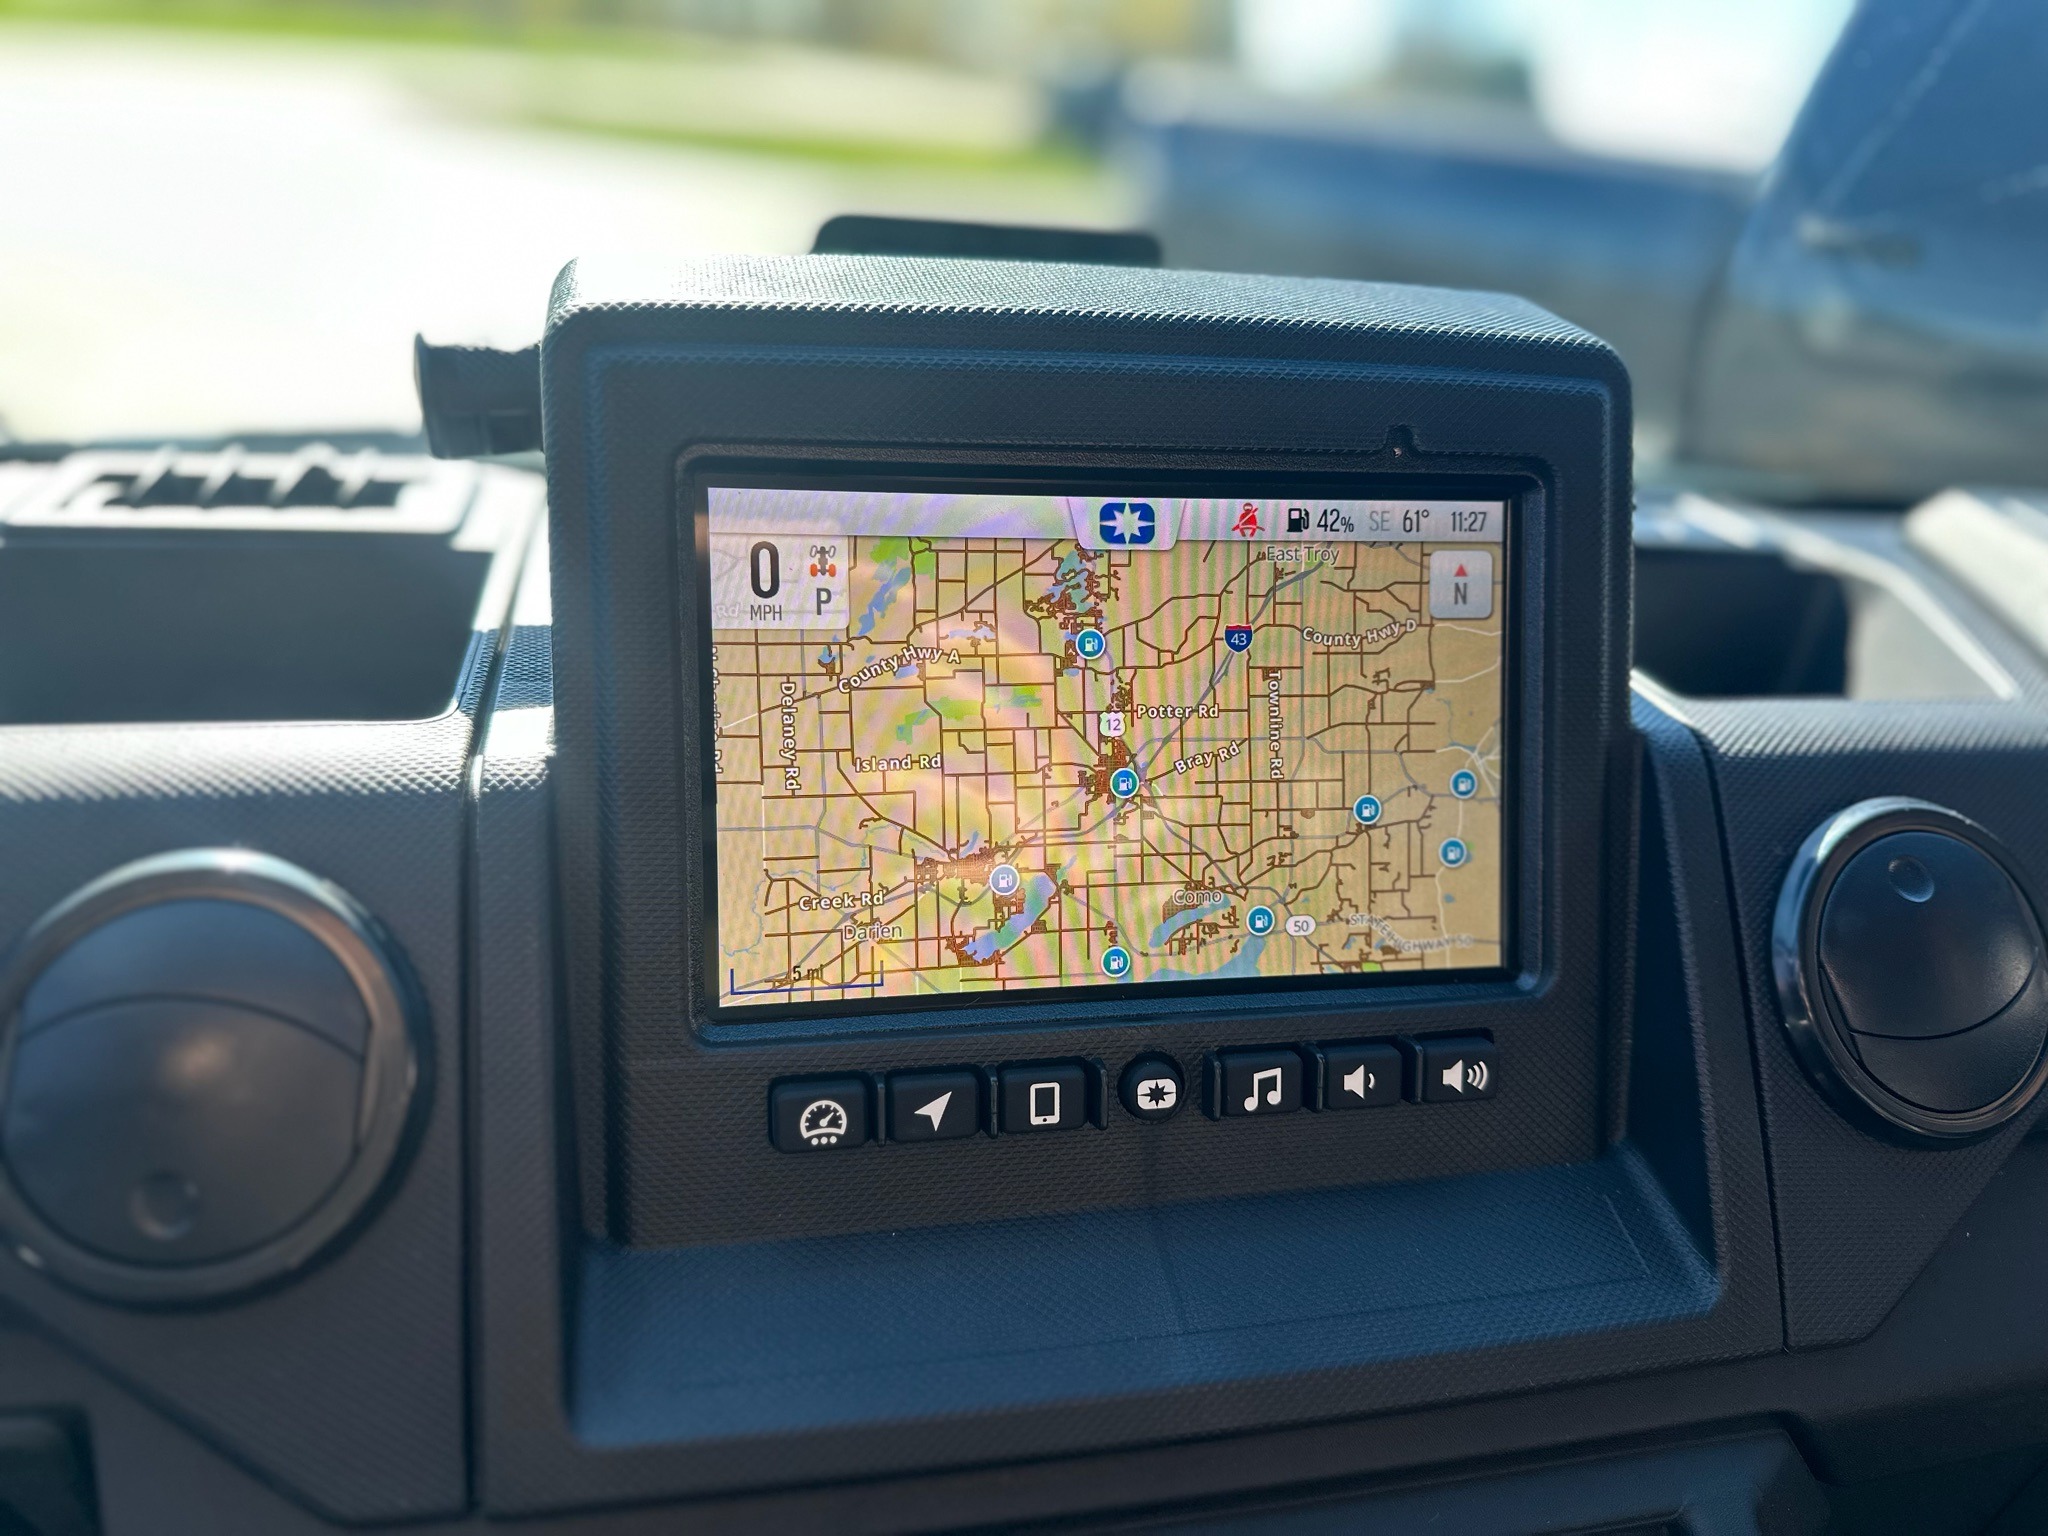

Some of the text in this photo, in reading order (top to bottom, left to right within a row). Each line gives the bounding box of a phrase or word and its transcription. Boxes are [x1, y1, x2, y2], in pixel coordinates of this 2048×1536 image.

[1317, 508, 1354, 533] 42%
[1369, 510, 1391, 532] SE
[1450, 511, 1487, 532] 11:27
[1266, 545, 1339, 565] East Troy
[750, 540, 780, 599] 0
[816, 587, 832, 616] P
[1453, 582, 1468, 605] N
[750, 604, 783, 621] MPH
[1230, 633, 1248, 646] 43
[1302, 618, 1418, 650] County Hwy D
[838, 644, 961, 694] County Hwy A
[1136, 703, 1220, 719] Potter Rd
[1105, 718, 1121, 732] 12
[1268, 669, 1285, 780] Townline Rd
[780, 681, 801, 791] Delaney Rd
[855, 752, 942, 772] Island Rd
[1174, 740, 1241, 775] Bray Rd
[799, 889, 885, 912] Creek Rd
[1173, 889, 1223, 905] Como
[843, 923, 903, 942] Darien
[1293, 920, 1310, 933] 50
[1349, 914, 1390, 936] STATE
[792, 965, 801, 981] 5
